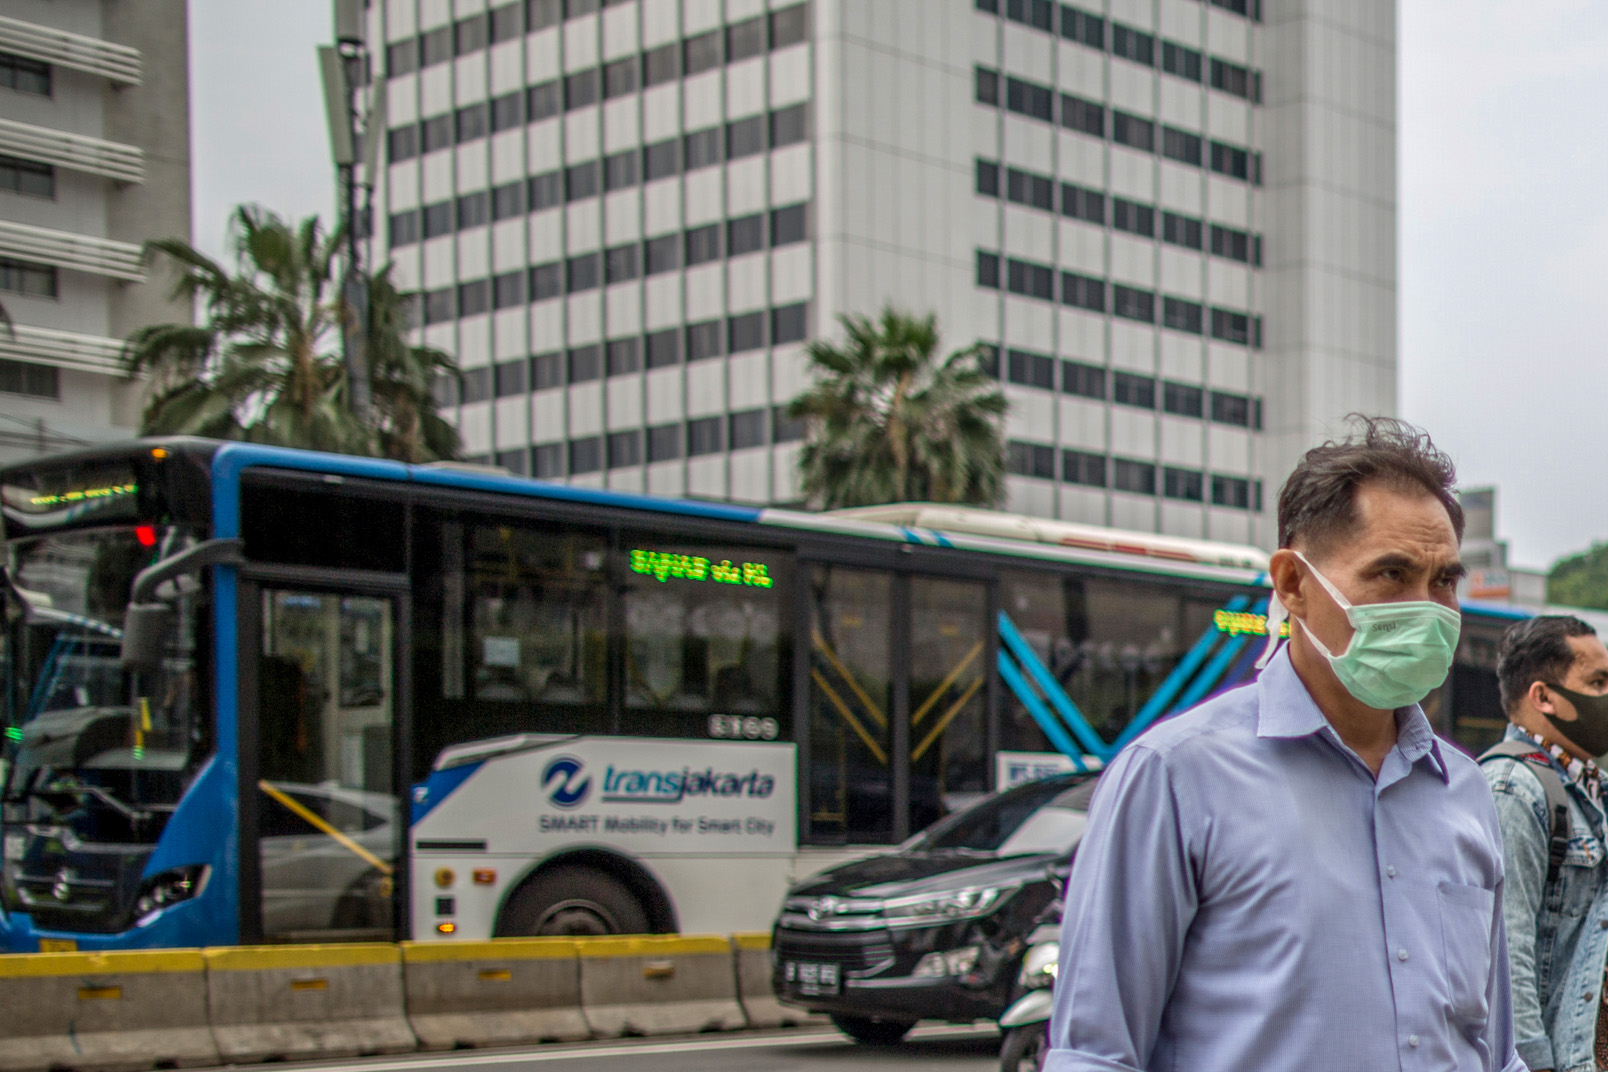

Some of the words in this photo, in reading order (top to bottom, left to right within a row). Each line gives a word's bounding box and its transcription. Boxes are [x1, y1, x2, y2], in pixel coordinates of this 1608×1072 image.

[602, 764, 775, 803] transjakarta
[539, 815, 599, 833] SMART
[604, 817, 668, 836] Mobility
[672, 817, 694, 833] for
[698, 817, 740, 834] Smart
[744, 817, 775, 836] City
